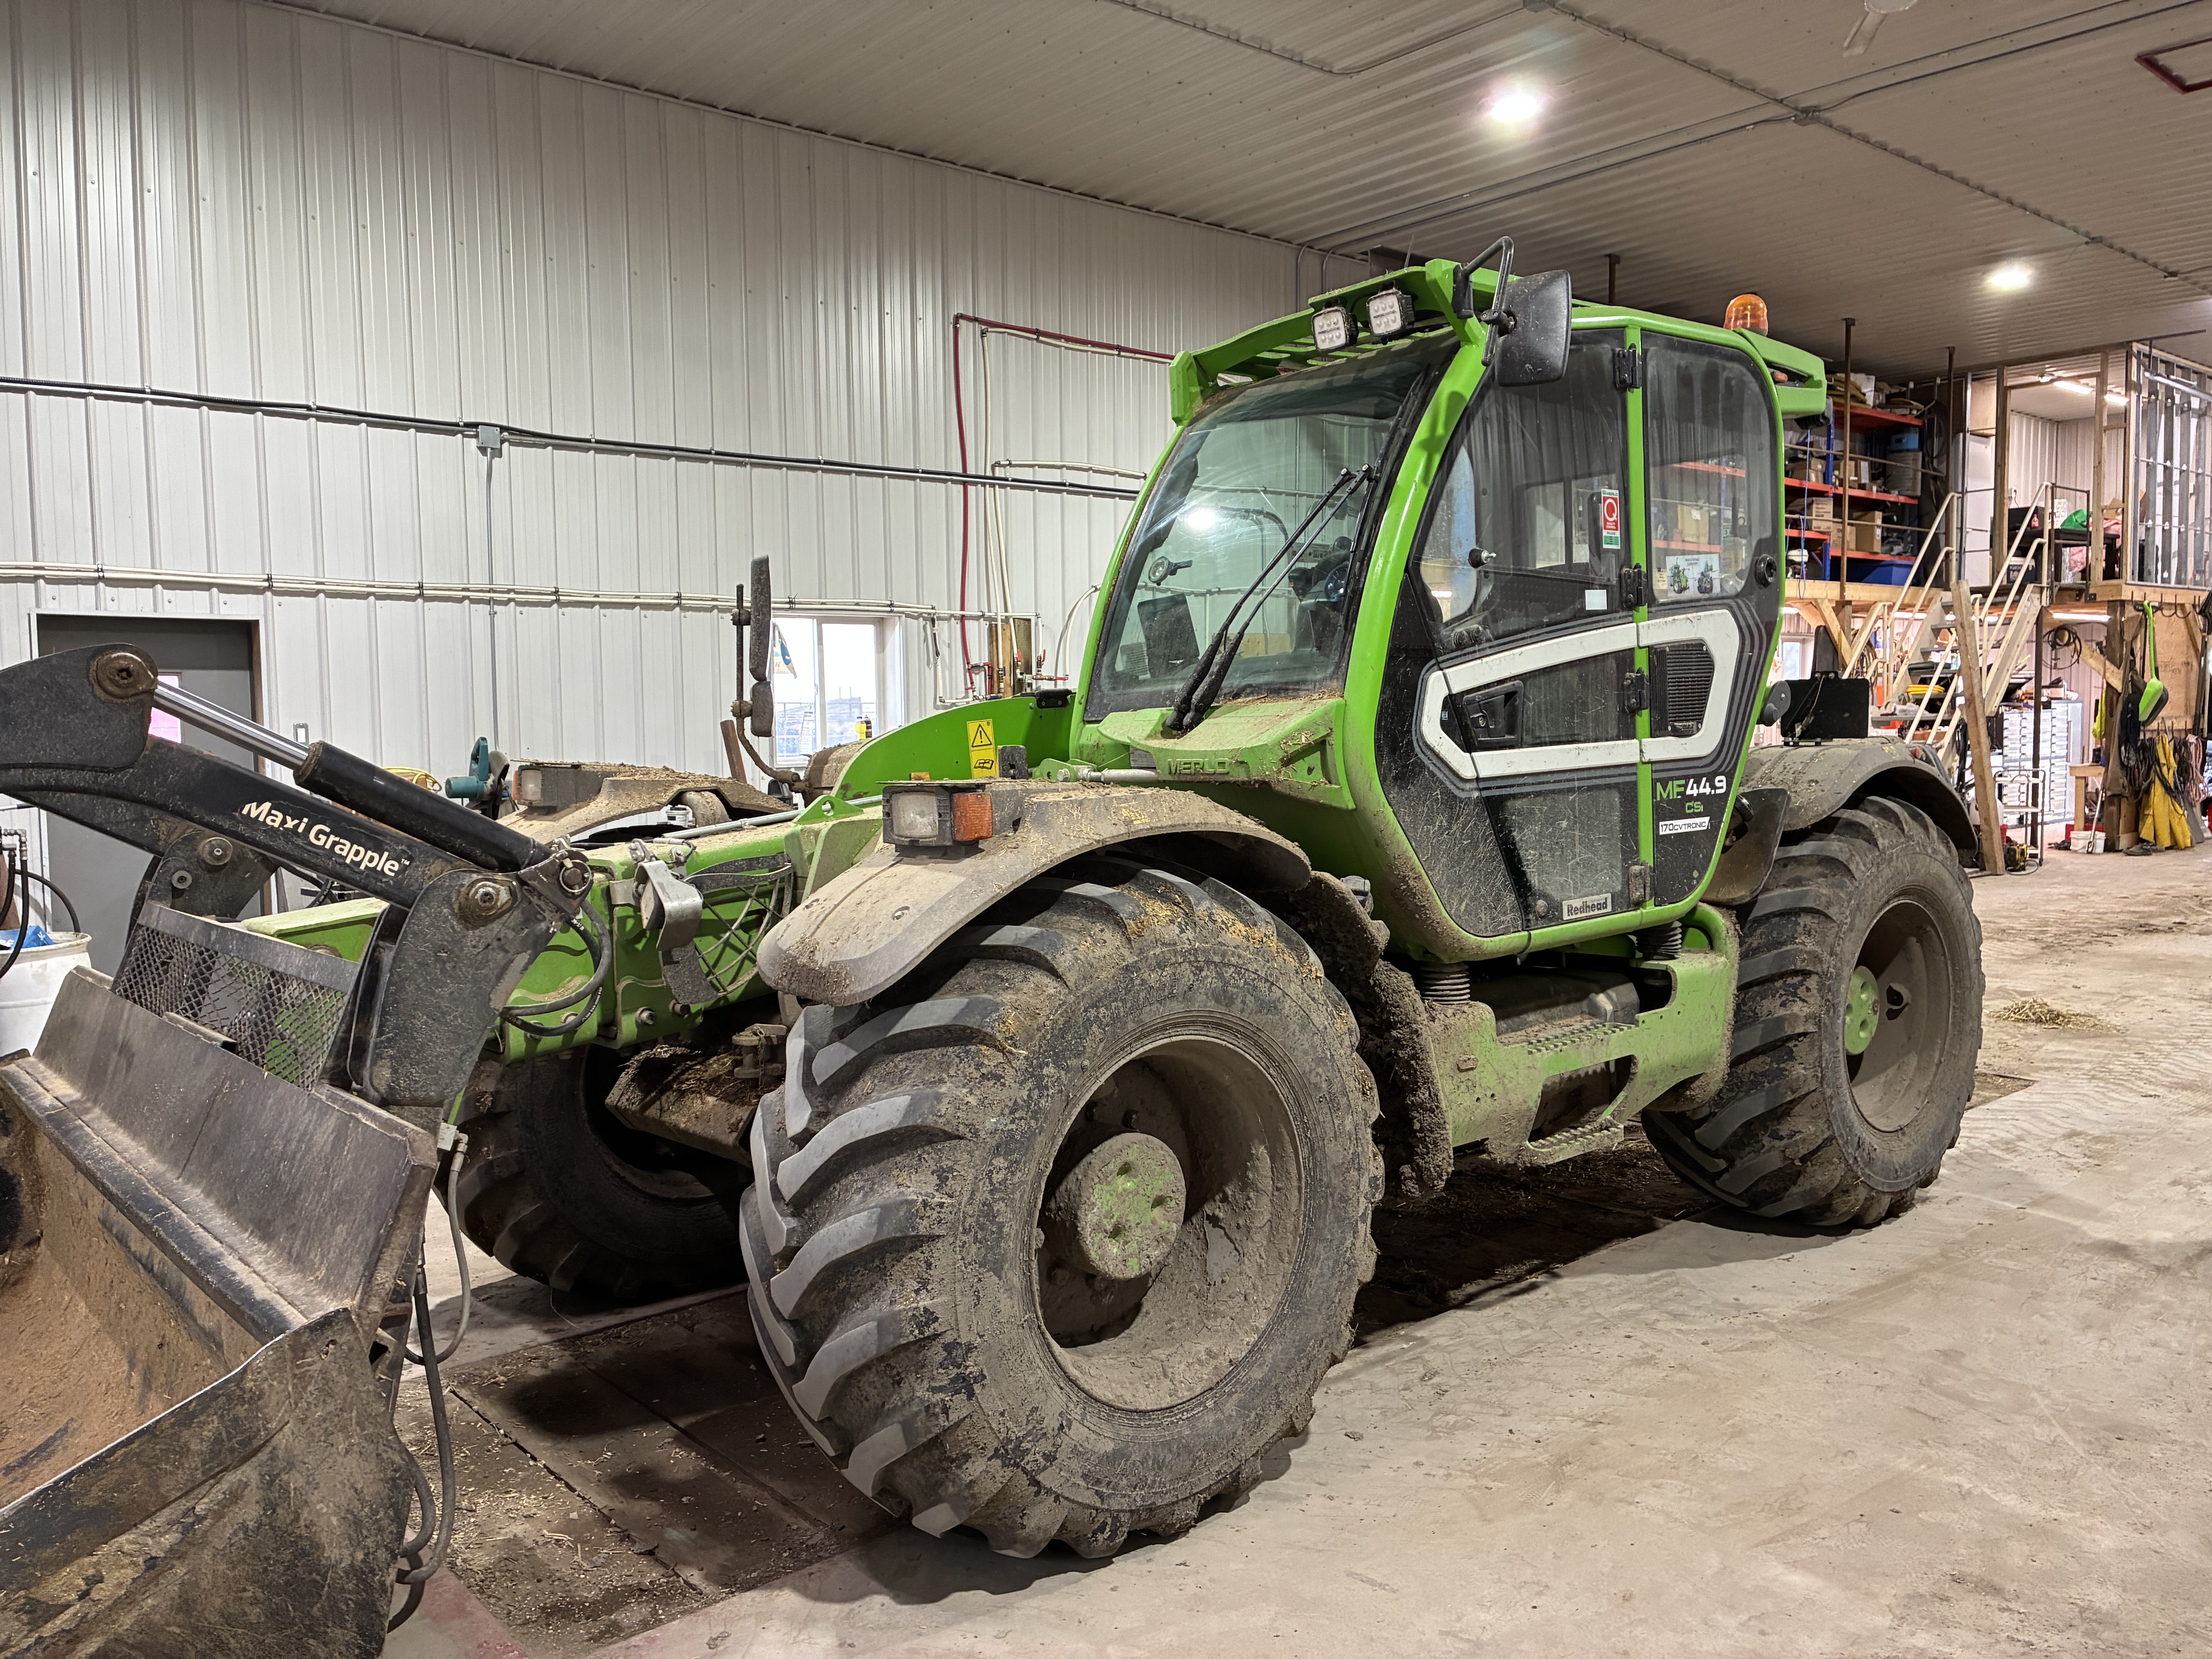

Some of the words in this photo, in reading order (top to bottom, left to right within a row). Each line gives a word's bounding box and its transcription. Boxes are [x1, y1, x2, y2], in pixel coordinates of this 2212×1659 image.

[1604, 498, 1617, 521] Q
[242, 802, 309, 833] Maxi
[1567, 897, 1607, 916] Redhead
